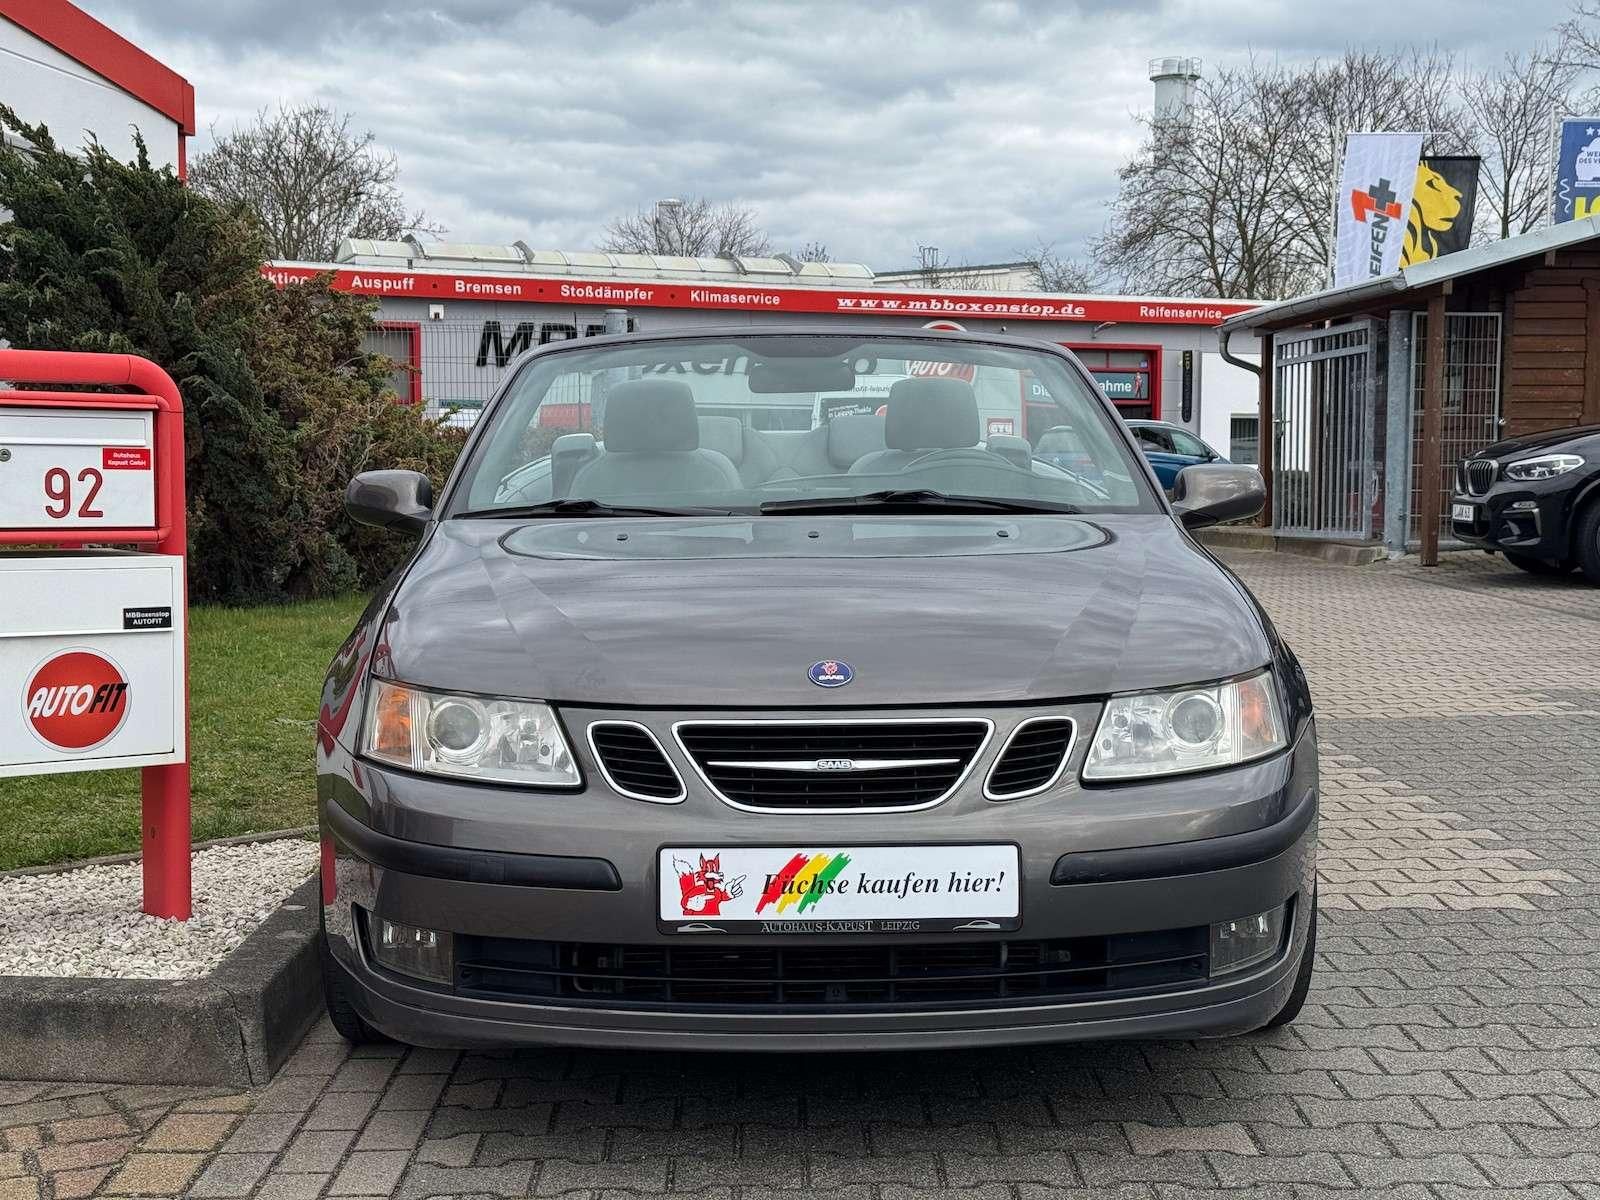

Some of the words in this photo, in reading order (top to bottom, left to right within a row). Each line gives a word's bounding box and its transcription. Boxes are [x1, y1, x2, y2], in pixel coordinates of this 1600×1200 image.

[351, 275, 415, 291] Auspuff
[454, 280, 522, 295] Bremsen
[560, 284, 654, 302] Stoßdämpfer
[690, 289, 781, 305] Klimaservice
[836, 297, 1086, 318] www.mbboxenstop.de
[1139, 305, 1222, 319] Reifenservice
[44, 467, 104, 519] 92
[27, 683, 128, 719] AUTOFIT
[818, 761, 851, 770] SAAB
[760, 872, 850, 895] Füchse
[856, 871, 939, 899] kaufen
[947, 871, 1005, 893] hier!
[881, 921, 920, 931] LEIPZIG
